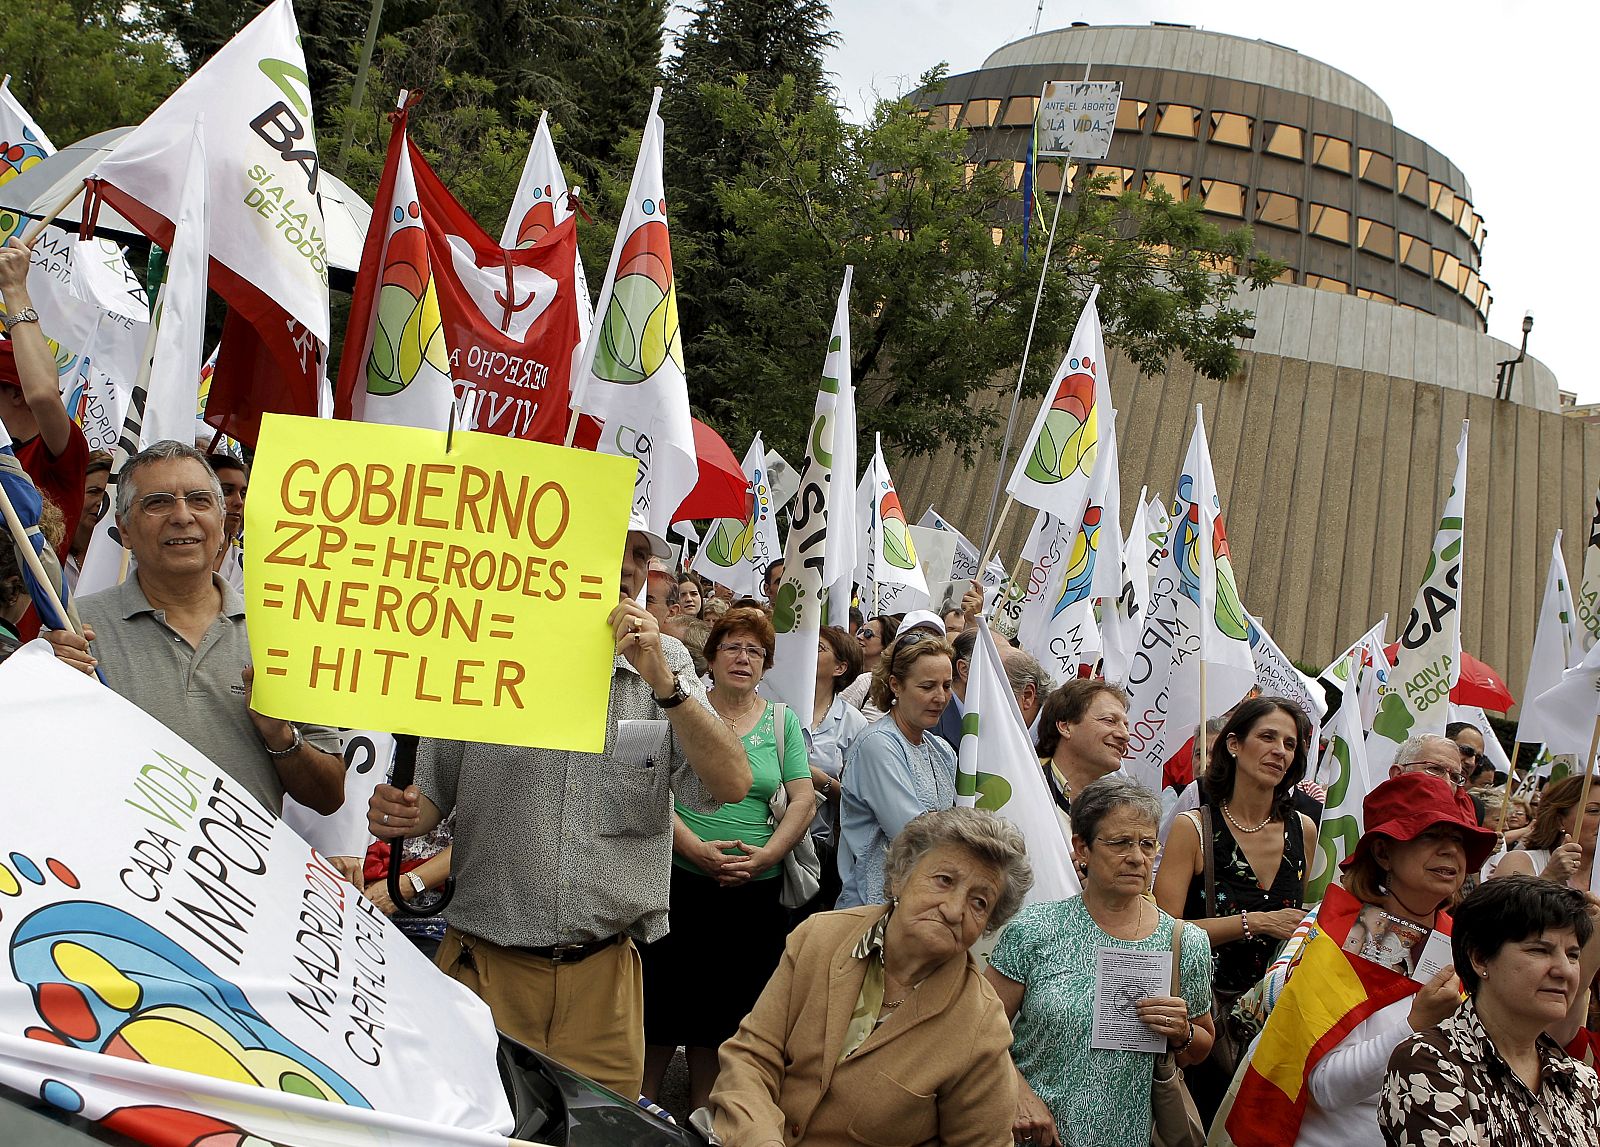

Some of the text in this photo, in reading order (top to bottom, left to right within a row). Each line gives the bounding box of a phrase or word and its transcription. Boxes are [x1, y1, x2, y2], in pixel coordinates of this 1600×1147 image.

[1044, 102, 1115, 111] ANTE EL ABORTO
[1049, 119, 1101, 132] LA VIDA
[244, 187, 279, 219] DE
[247, 164, 276, 186] SÍ
[266, 186, 284, 204] A
[283, 199, 308, 230] LA
[280, 458, 570, 550] GOBIERNO
[309, 645, 527, 710] HITLER
[119, 749, 207, 902] CADA VIDA
[165, 776, 278, 966] IMPORT
[345, 957, 387, 1067] CAPITAL
